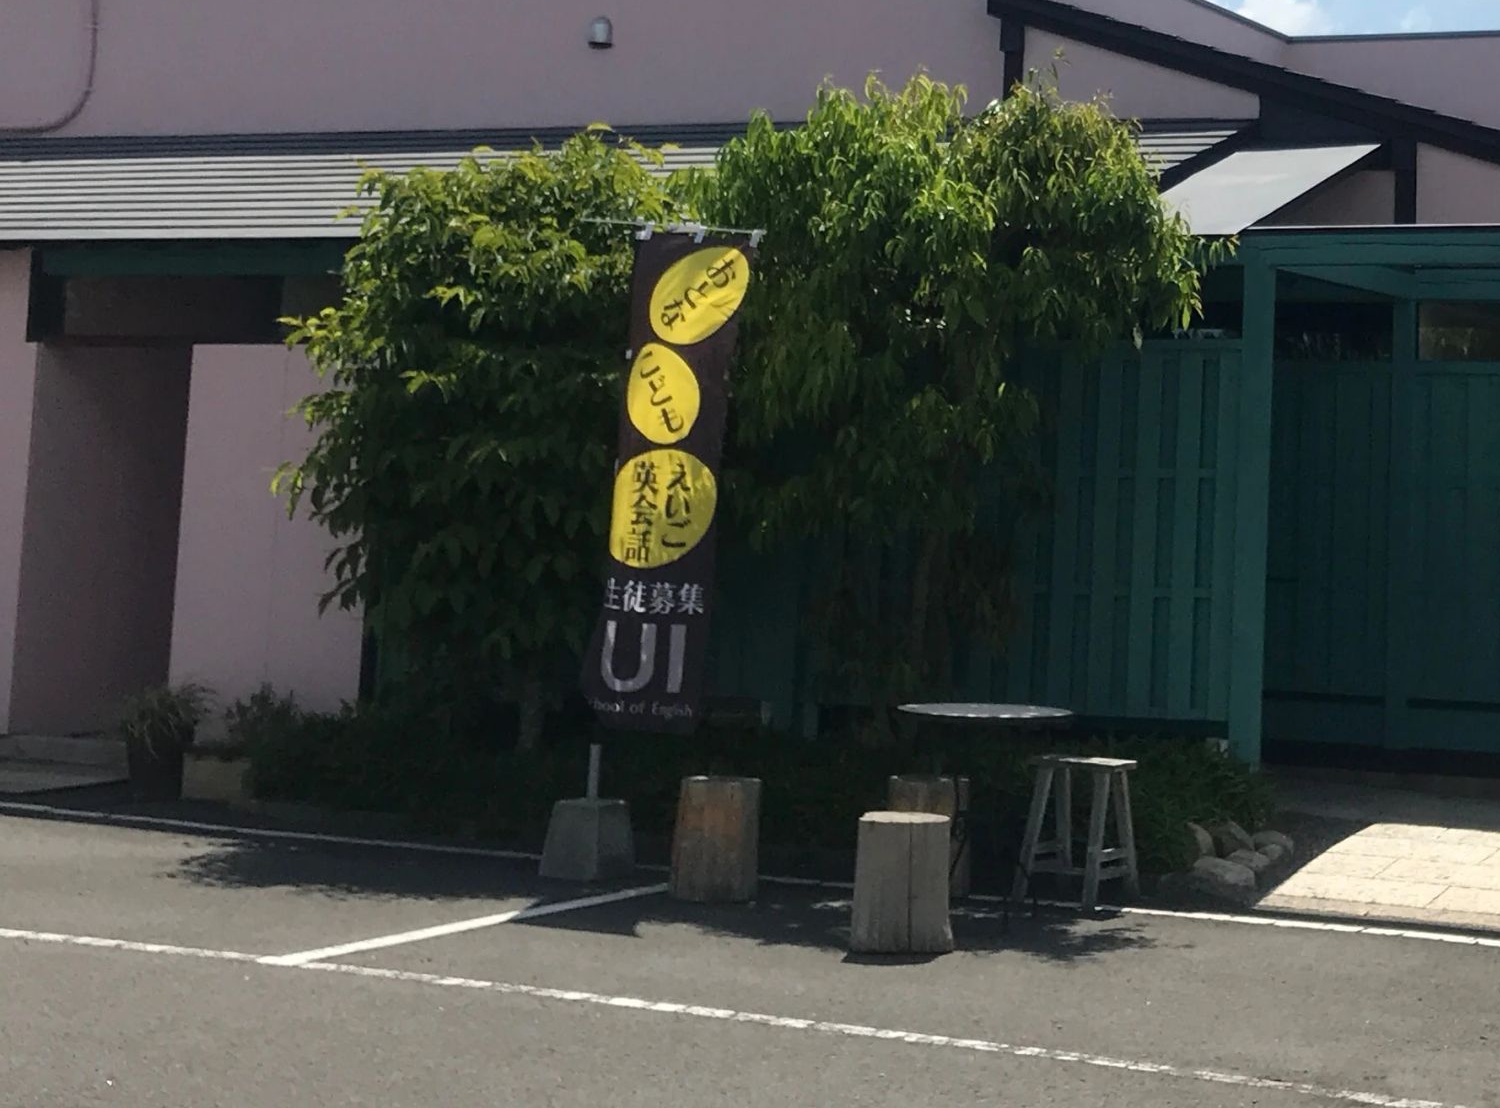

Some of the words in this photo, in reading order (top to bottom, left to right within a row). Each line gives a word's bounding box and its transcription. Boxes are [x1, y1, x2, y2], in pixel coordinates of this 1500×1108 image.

[661, 258, 737, 331] おとな
[624, 460, 658, 563] 英会話
[664, 462, 693, 549] えいご
[604, 577, 704, 615] 生徒募集
[601, 620, 688, 694] UI
